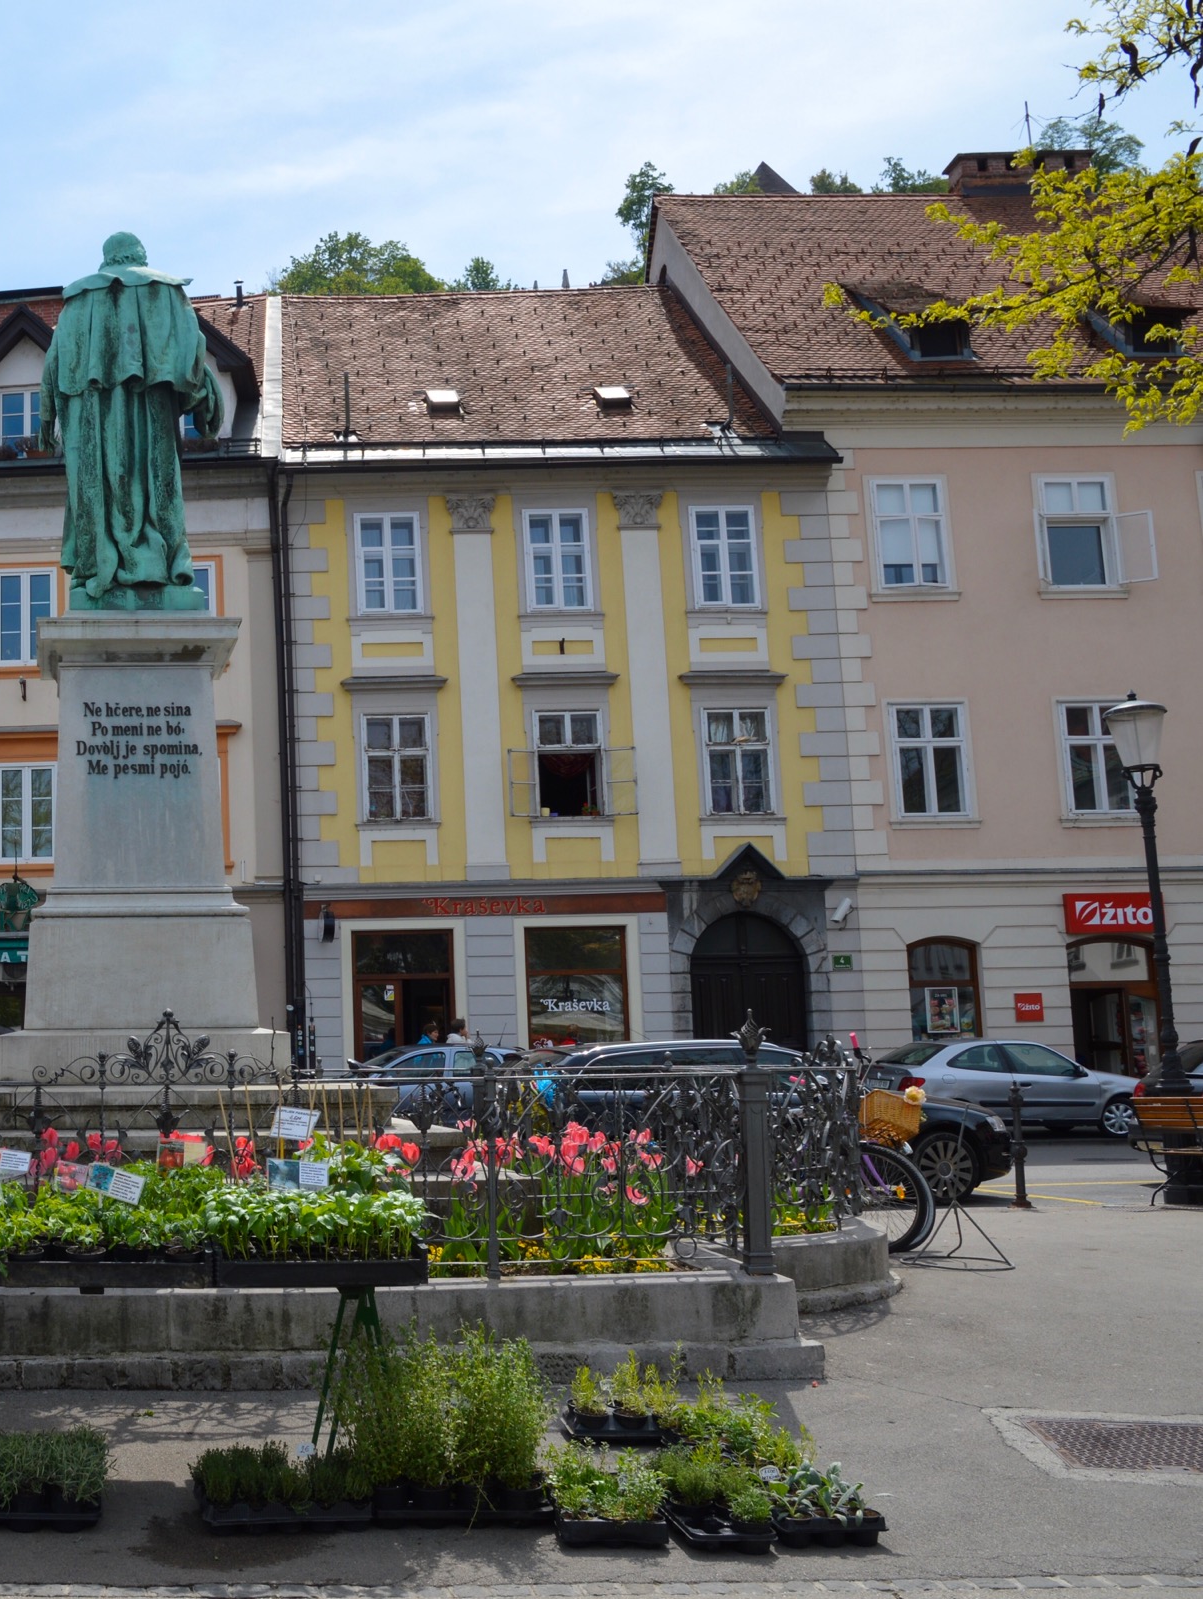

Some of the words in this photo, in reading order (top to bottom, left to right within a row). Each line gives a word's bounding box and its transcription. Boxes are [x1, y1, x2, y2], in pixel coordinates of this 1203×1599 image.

[83, 702, 102, 717] Ne
[105, 702, 144, 718] hčere,
[146, 706, 161, 717] ne
[164, 702, 191, 717] sina
[91, 721, 108, 736] Po
[111, 722, 143, 736] meni
[146, 725, 162, 736] ne
[122, 741, 137, 759] je
[143, 741, 203, 759] spomina,
[87, 760, 108, 775] Me
[113, 760, 155, 779] pesmi
[160, 760, 191, 779] pojó.
[422, 896, 546, 916] Kraševka
[1101, 901, 1154, 925] žito
[540, 998, 610, 1012] Kraševka
